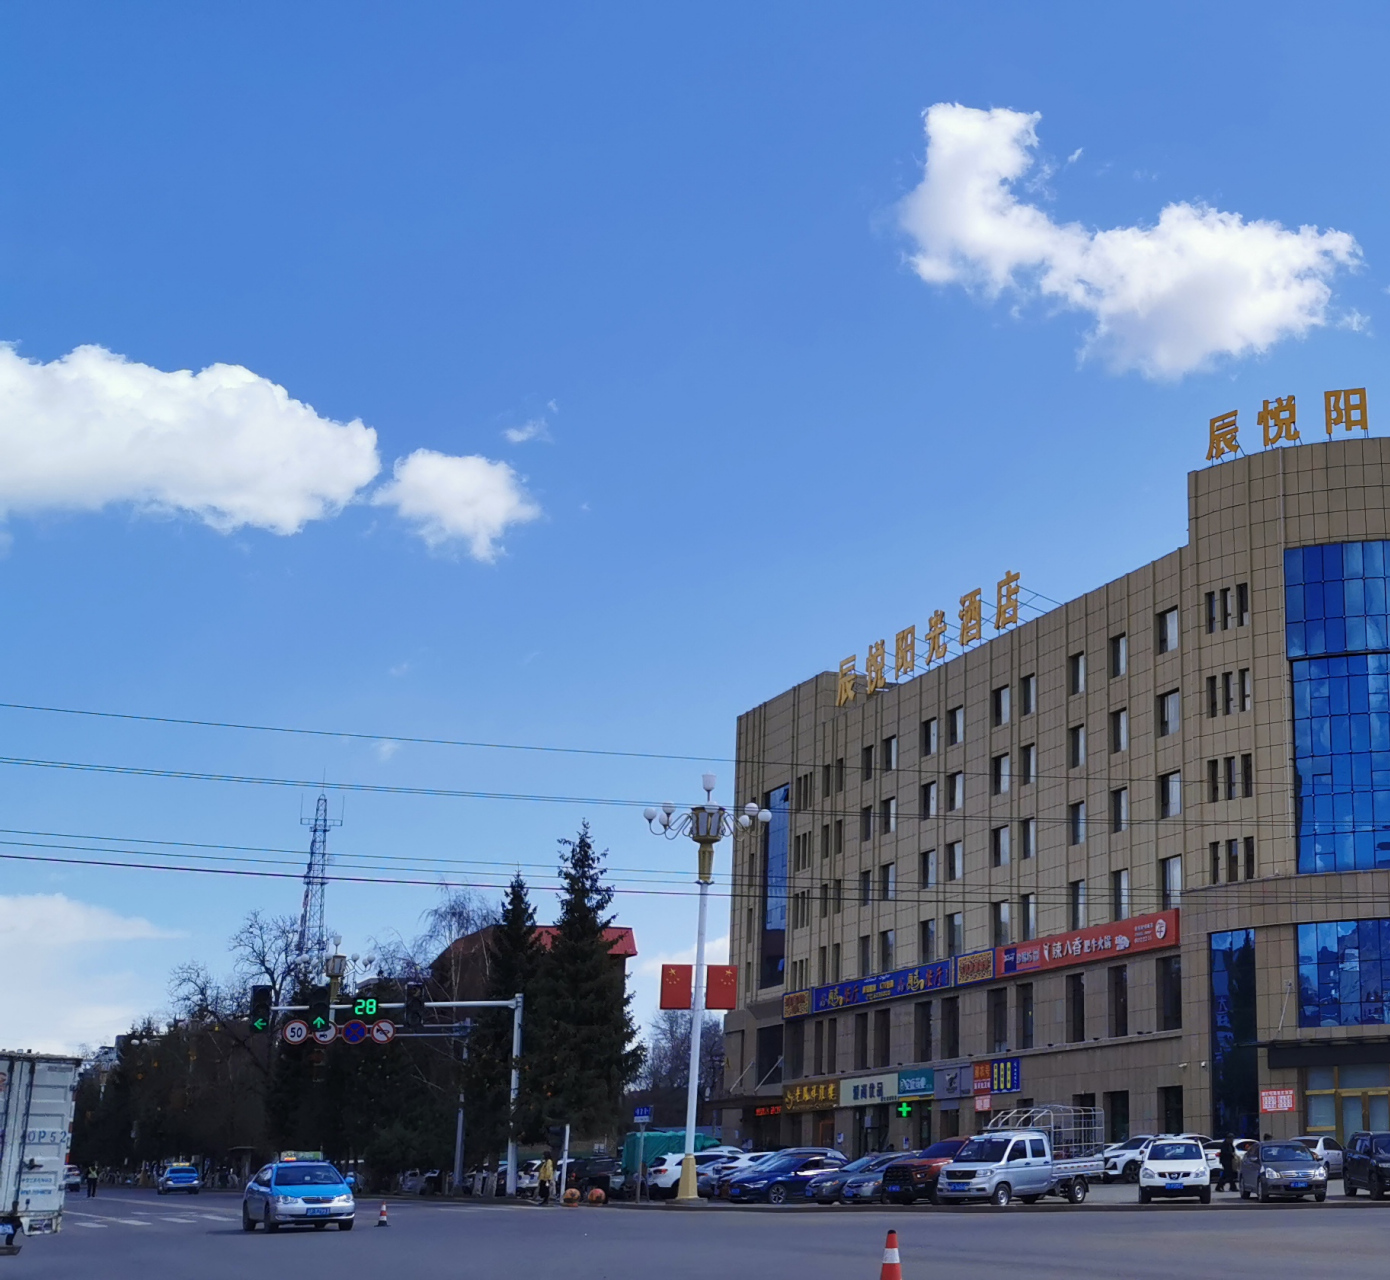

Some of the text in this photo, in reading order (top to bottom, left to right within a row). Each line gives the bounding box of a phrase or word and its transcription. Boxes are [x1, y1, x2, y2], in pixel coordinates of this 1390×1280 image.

[835, 570, 1020, 707] 辰悦阳光酒店
[354, 999, 377, 1015] 28
[289, 1027, 302, 1038] 50
